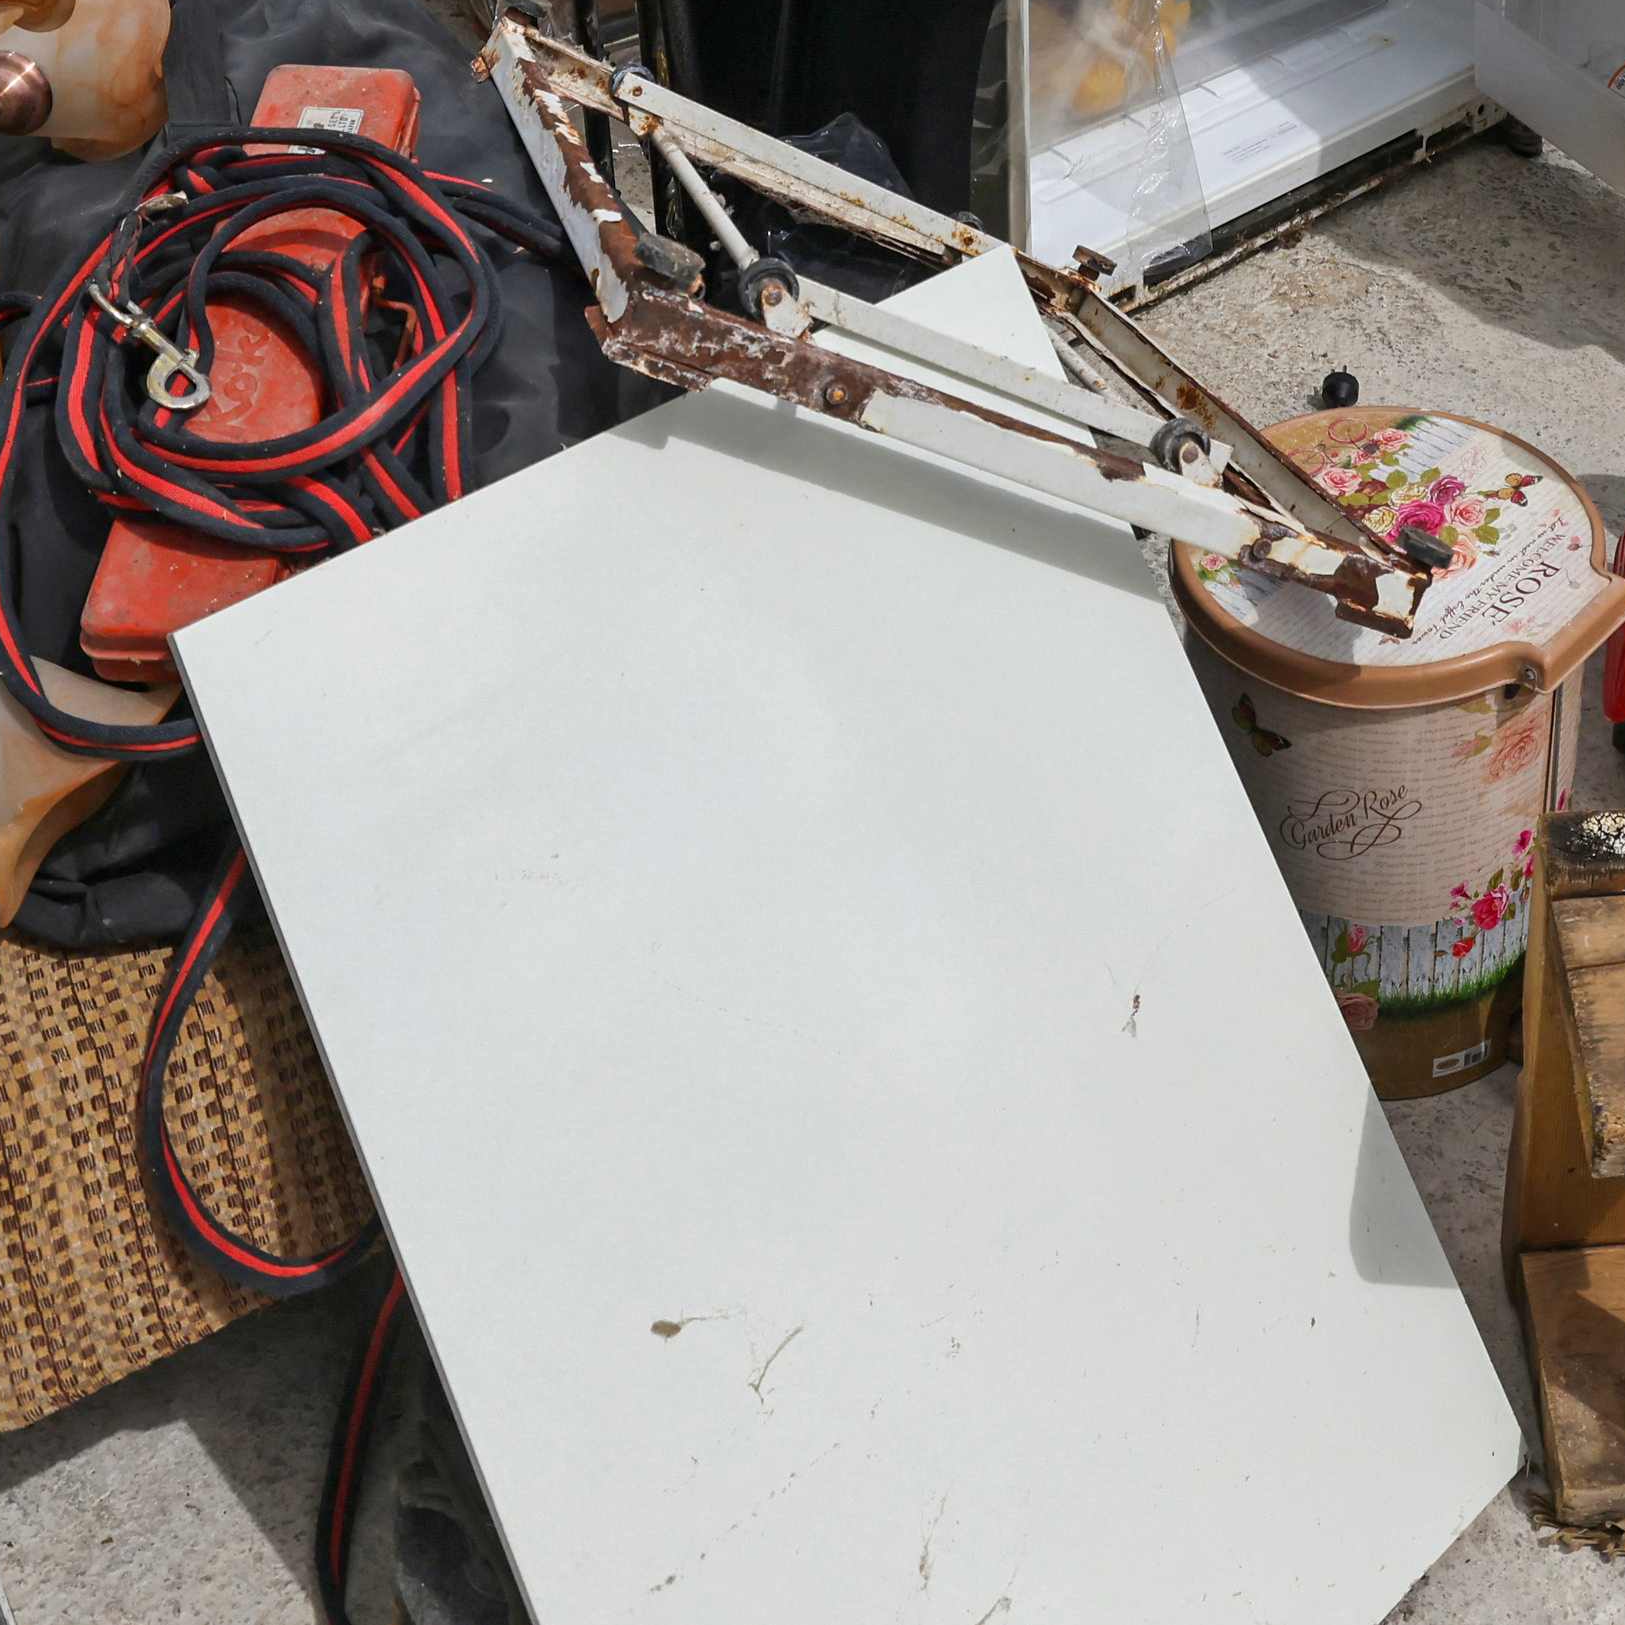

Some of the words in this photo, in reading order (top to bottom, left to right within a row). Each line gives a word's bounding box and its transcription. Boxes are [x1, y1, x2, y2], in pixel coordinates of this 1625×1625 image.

[1504, 532, 1566, 581] WELCOME
[1485, 582, 1507, 601] MY
[1439, 599, 1486, 641] FRIEND
[1280, 790, 1360, 849] Garden
